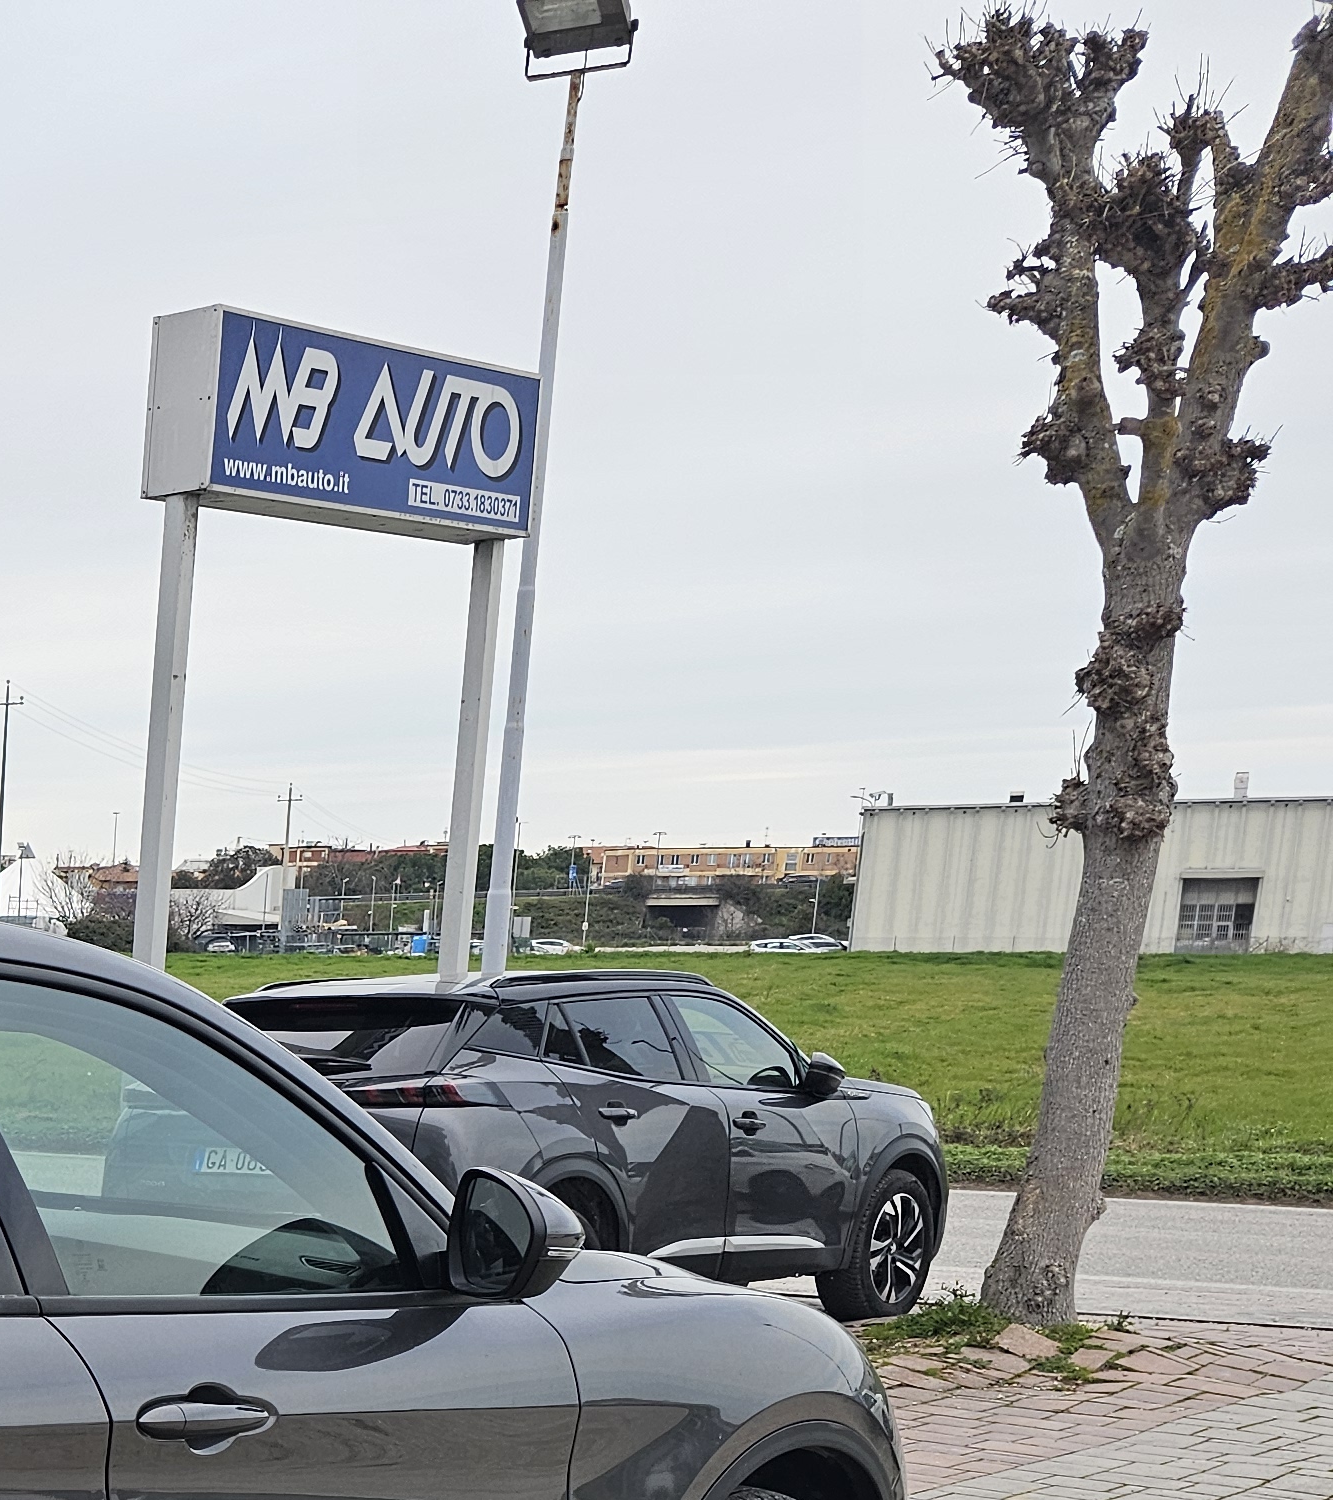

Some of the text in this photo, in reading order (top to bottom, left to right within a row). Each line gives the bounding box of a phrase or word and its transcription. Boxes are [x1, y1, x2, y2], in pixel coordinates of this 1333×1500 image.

[226, 320, 522, 478] MB AUTO
[223, 457, 350, 494] www.mbauto.it
[412, 482, 519, 519] TEL. 0733.1830371
[206, 1149, 228, 1170] GA
